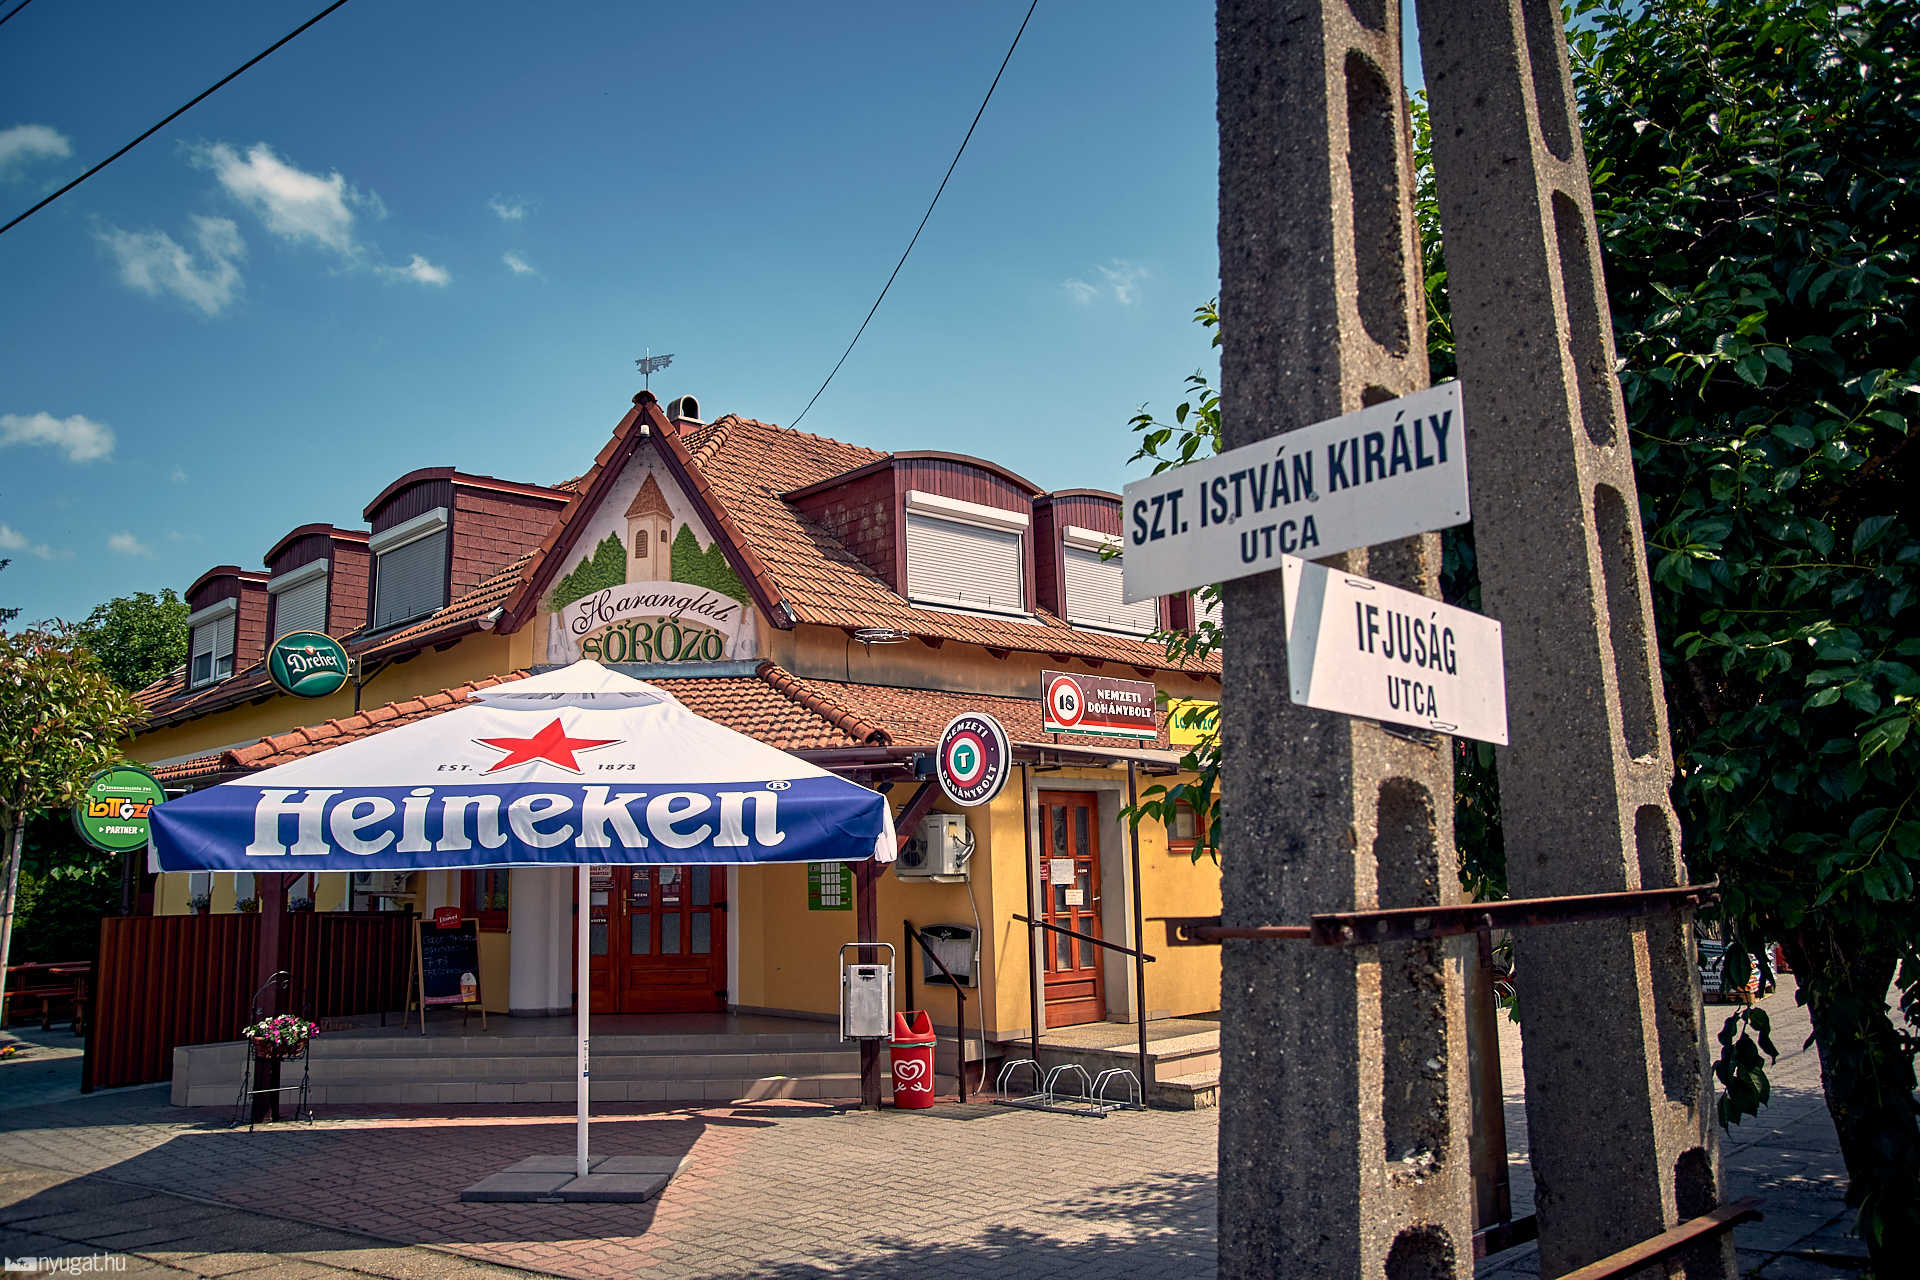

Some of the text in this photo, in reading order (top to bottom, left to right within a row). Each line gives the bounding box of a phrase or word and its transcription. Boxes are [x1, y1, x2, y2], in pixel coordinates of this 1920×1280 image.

[1132, 410, 1453, 546] SZT. ISTVÁN KIRÁLY
[1241, 514, 1321, 564] UTCA
[572, 589, 738, 635] Harangláb
[1356, 600, 1457, 676] IFJUSÁG
[287, 651, 338, 675] Dreher
[1059, 694, 1075, 711] 18
[1097, 688, 1142, 703] NEMZETI
[1387, 674, 1438, 718] UTCA
[1087, 701, 1152, 718] DOHÁNYBOLT
[946, 721, 988, 743] NEMZETI
[437, 763, 636, 772] EST. 1873
[958, 752, 970, 768] T
[943, 763, 997, 799] DOHÁNYBOLT
[105, 825, 138, 834] PARTNER
[245, 785, 787, 857] Heineken
